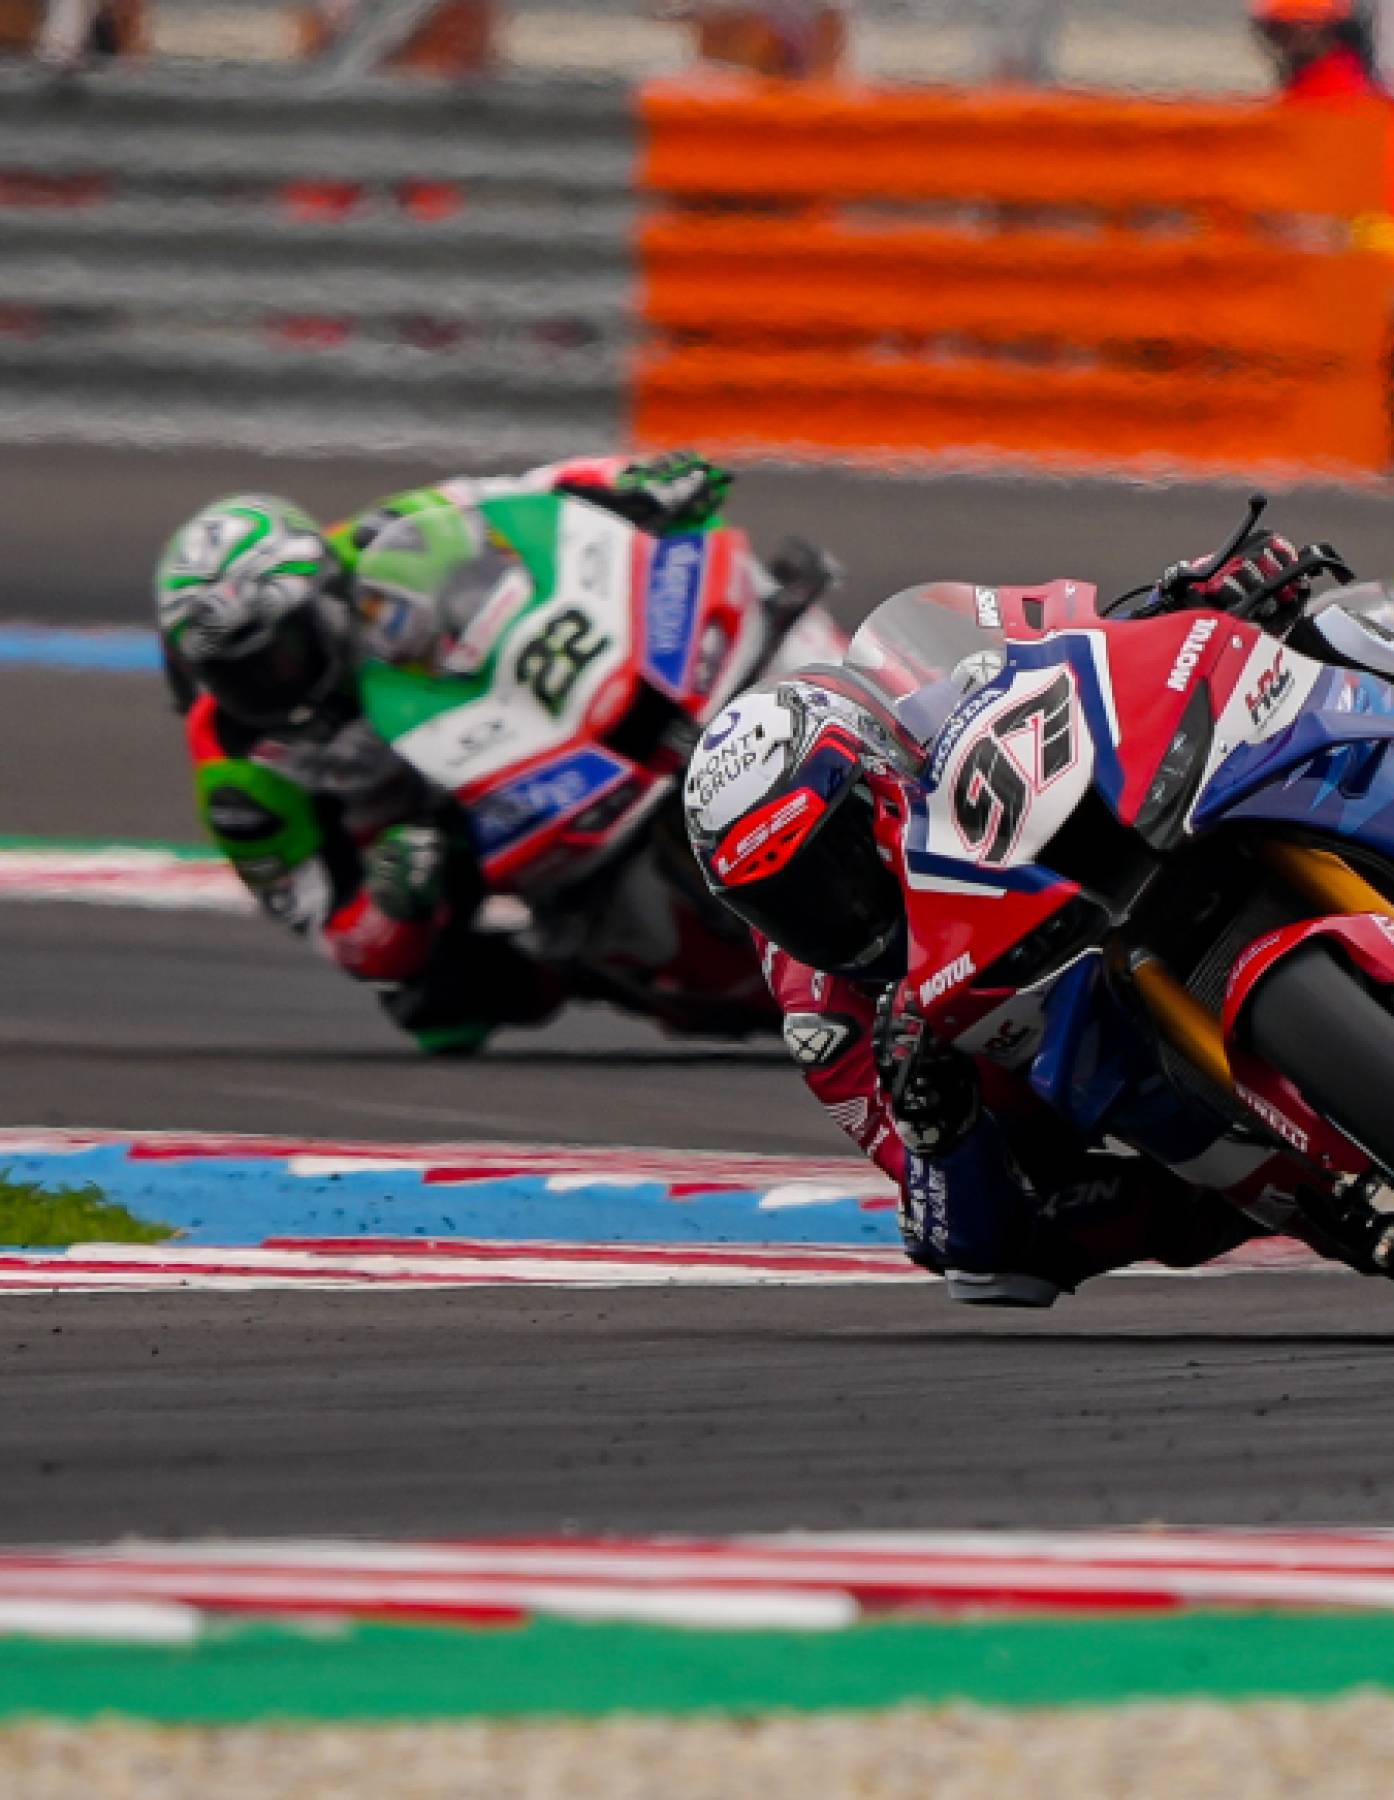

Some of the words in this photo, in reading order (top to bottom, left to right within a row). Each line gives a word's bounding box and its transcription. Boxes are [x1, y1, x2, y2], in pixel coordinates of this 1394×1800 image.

[516, 608, 614, 720] 22
[1167, 616, 1218, 693] MOTUL
[1244, 643, 1298, 727] HRC
[931, 689, 1009, 782] HONDA
[953, 667, 1078, 868] 97
[702, 752, 757, 806] GRUP
[919, 950, 978, 1008] MOTUL
